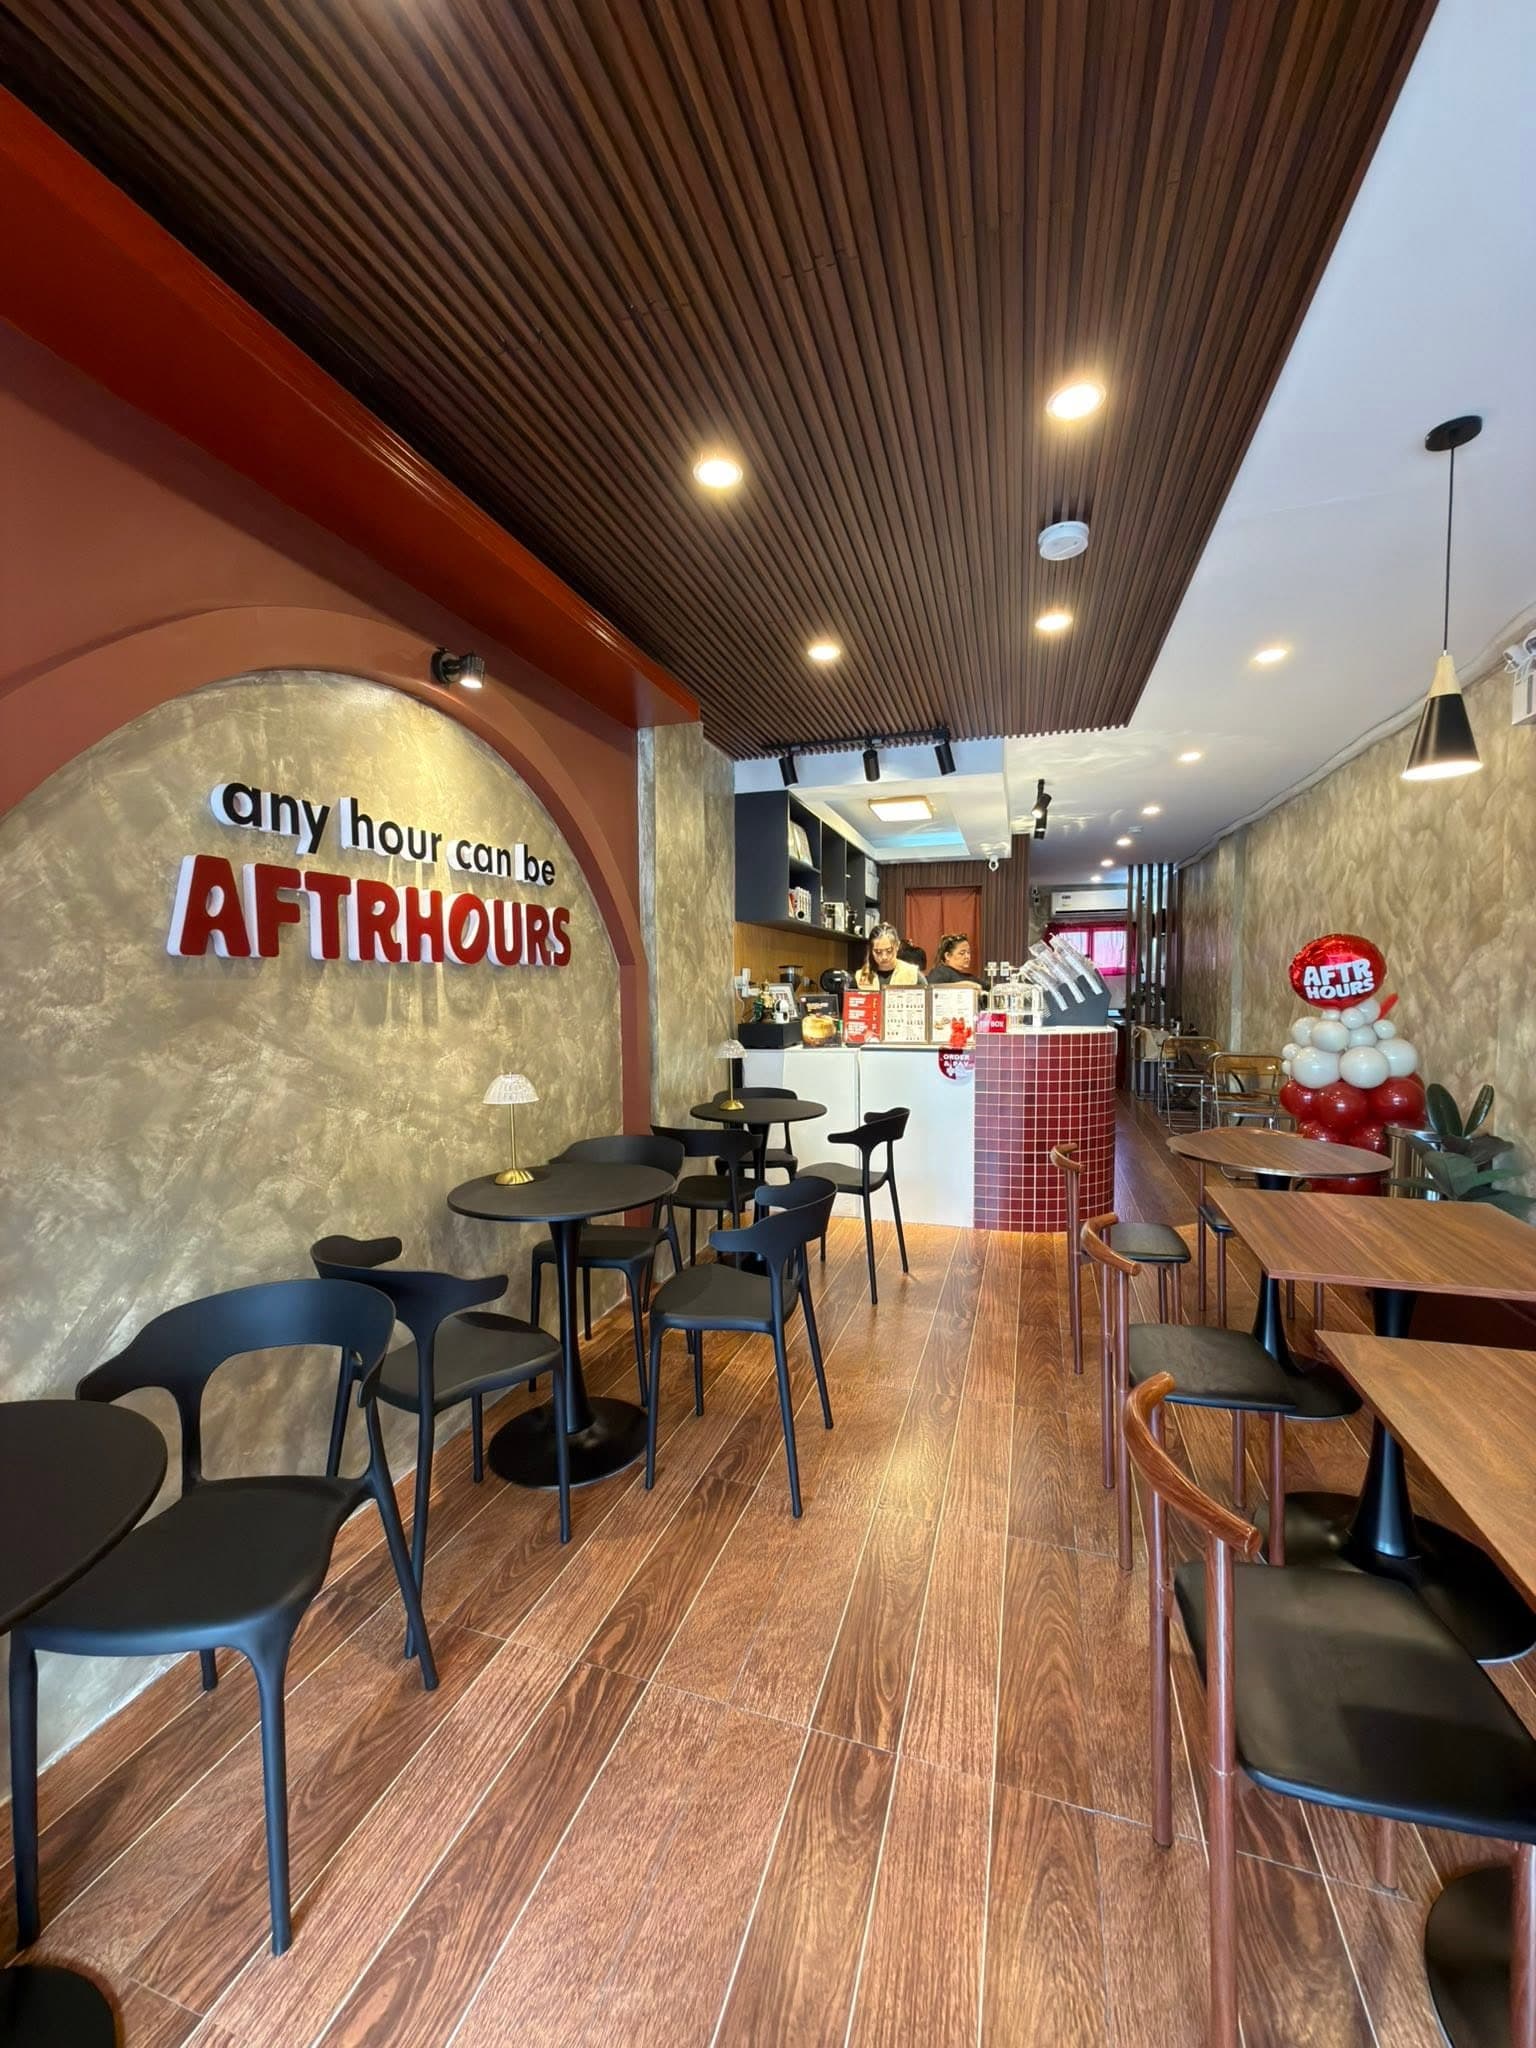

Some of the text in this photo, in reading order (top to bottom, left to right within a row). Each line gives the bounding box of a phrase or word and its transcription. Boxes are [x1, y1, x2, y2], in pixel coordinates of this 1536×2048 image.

[221, 781, 556, 887] any hour can be
[176, 854, 571, 967] AFTRHOURS
[1304, 959, 1372, 986] AFTR
[1305, 978, 1374, 999] HOURS
[990, 1020, 1004, 1028] BOX
